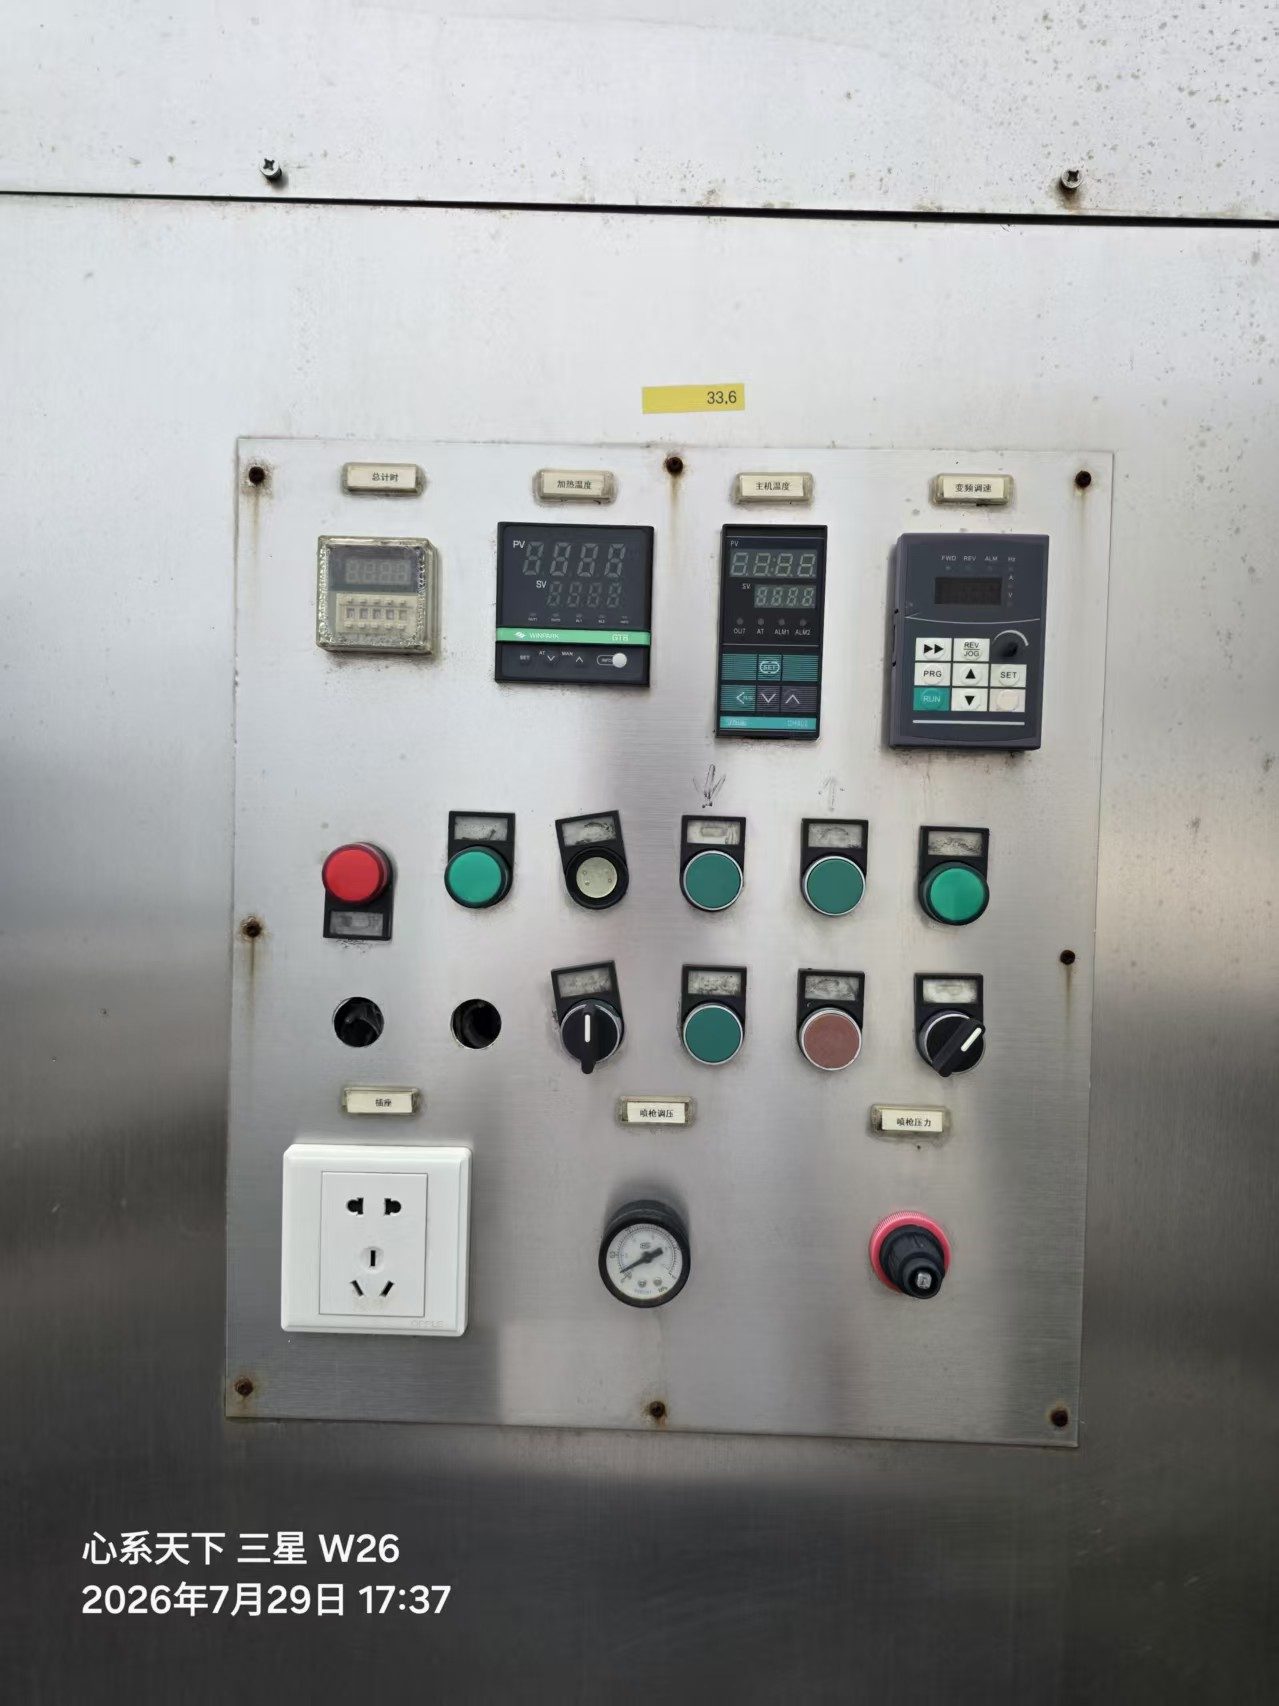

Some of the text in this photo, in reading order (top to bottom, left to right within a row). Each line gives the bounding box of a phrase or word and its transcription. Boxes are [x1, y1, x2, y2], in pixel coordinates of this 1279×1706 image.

[371, 472, 399, 482] 总计时
[557, 479, 592, 490] 加热温度
[755, 481, 791, 491] 主机温度
[955, 483, 992, 493] 变频调速
[512, 540, 525, 549] PV
[536, 580, 547, 589] SV
[964, 641, 980, 649] REV
[923, 670, 942, 678] PRG
[1000, 671, 1018, 679] SET
[923, 695, 941, 703] RUN
[896, 1117, 932, 1127] 喷枪压力
